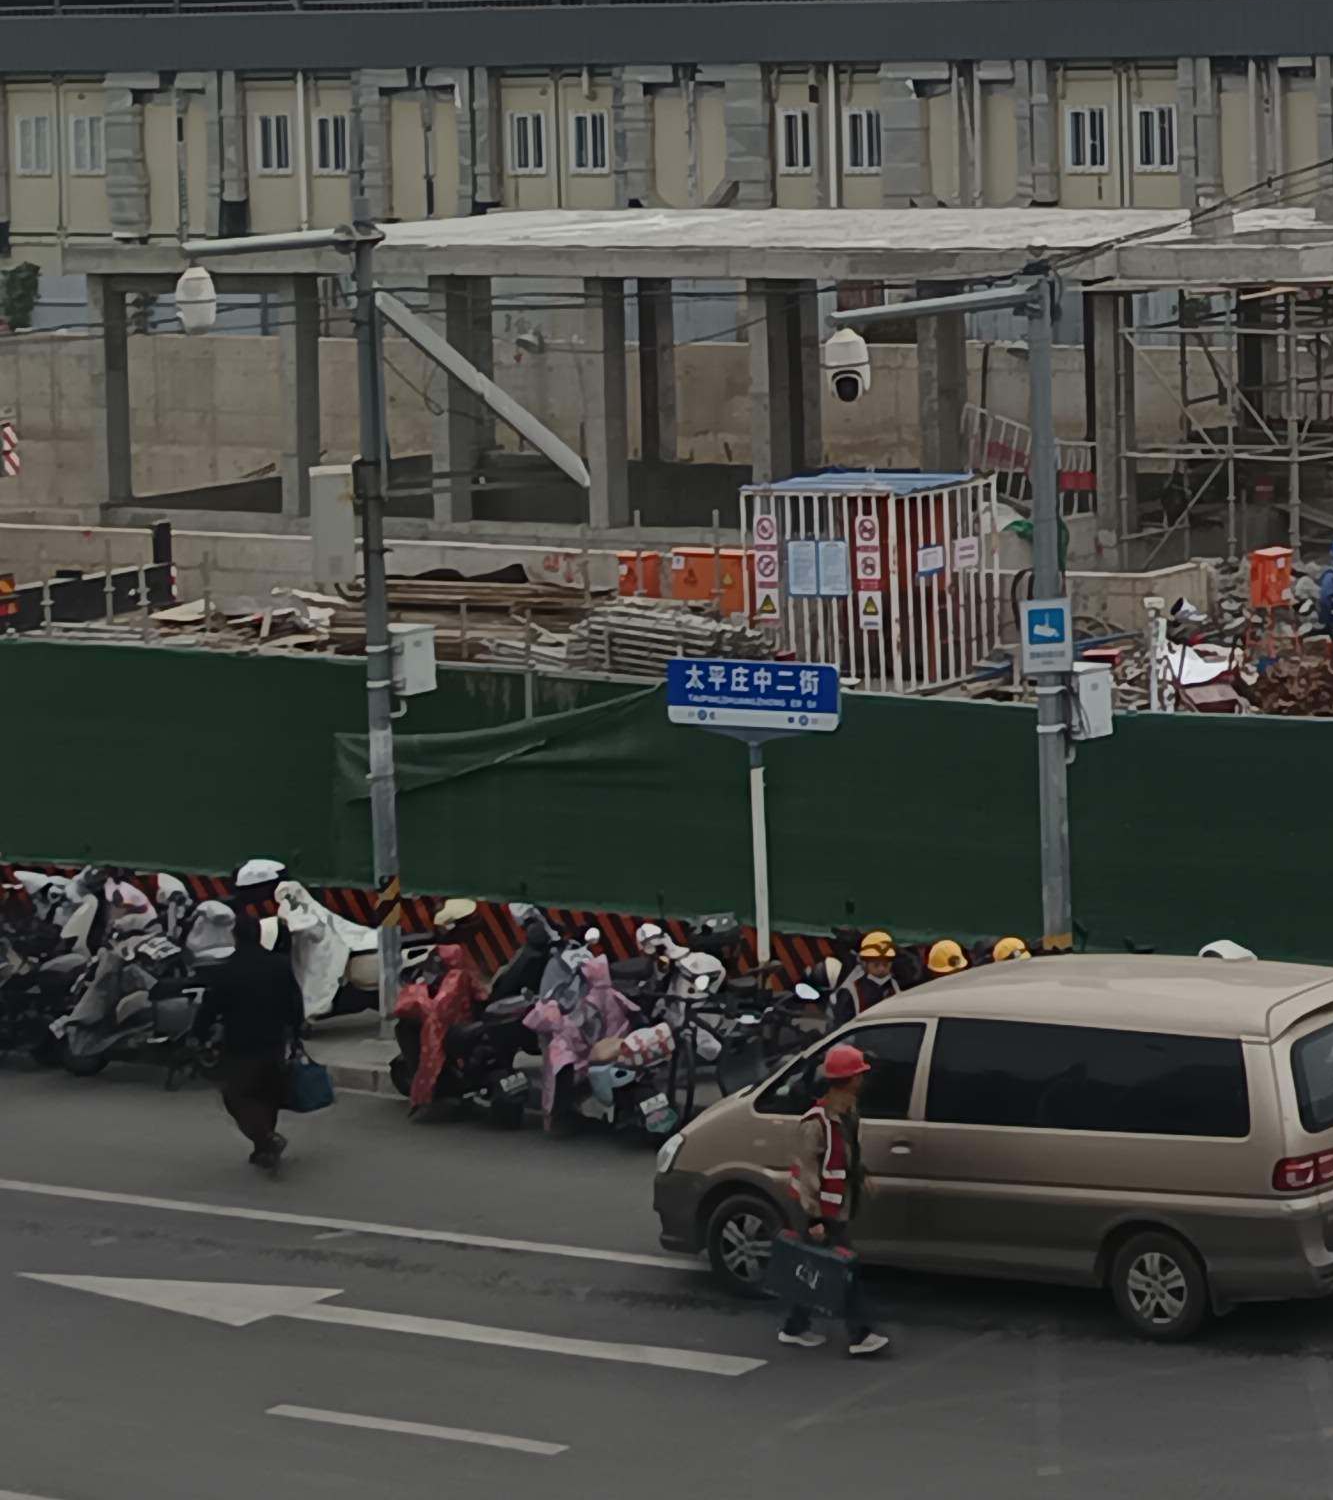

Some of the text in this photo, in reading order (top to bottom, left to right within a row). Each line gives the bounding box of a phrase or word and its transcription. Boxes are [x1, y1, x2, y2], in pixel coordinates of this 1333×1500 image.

[685, 664, 820, 696] 太平庄中二街
